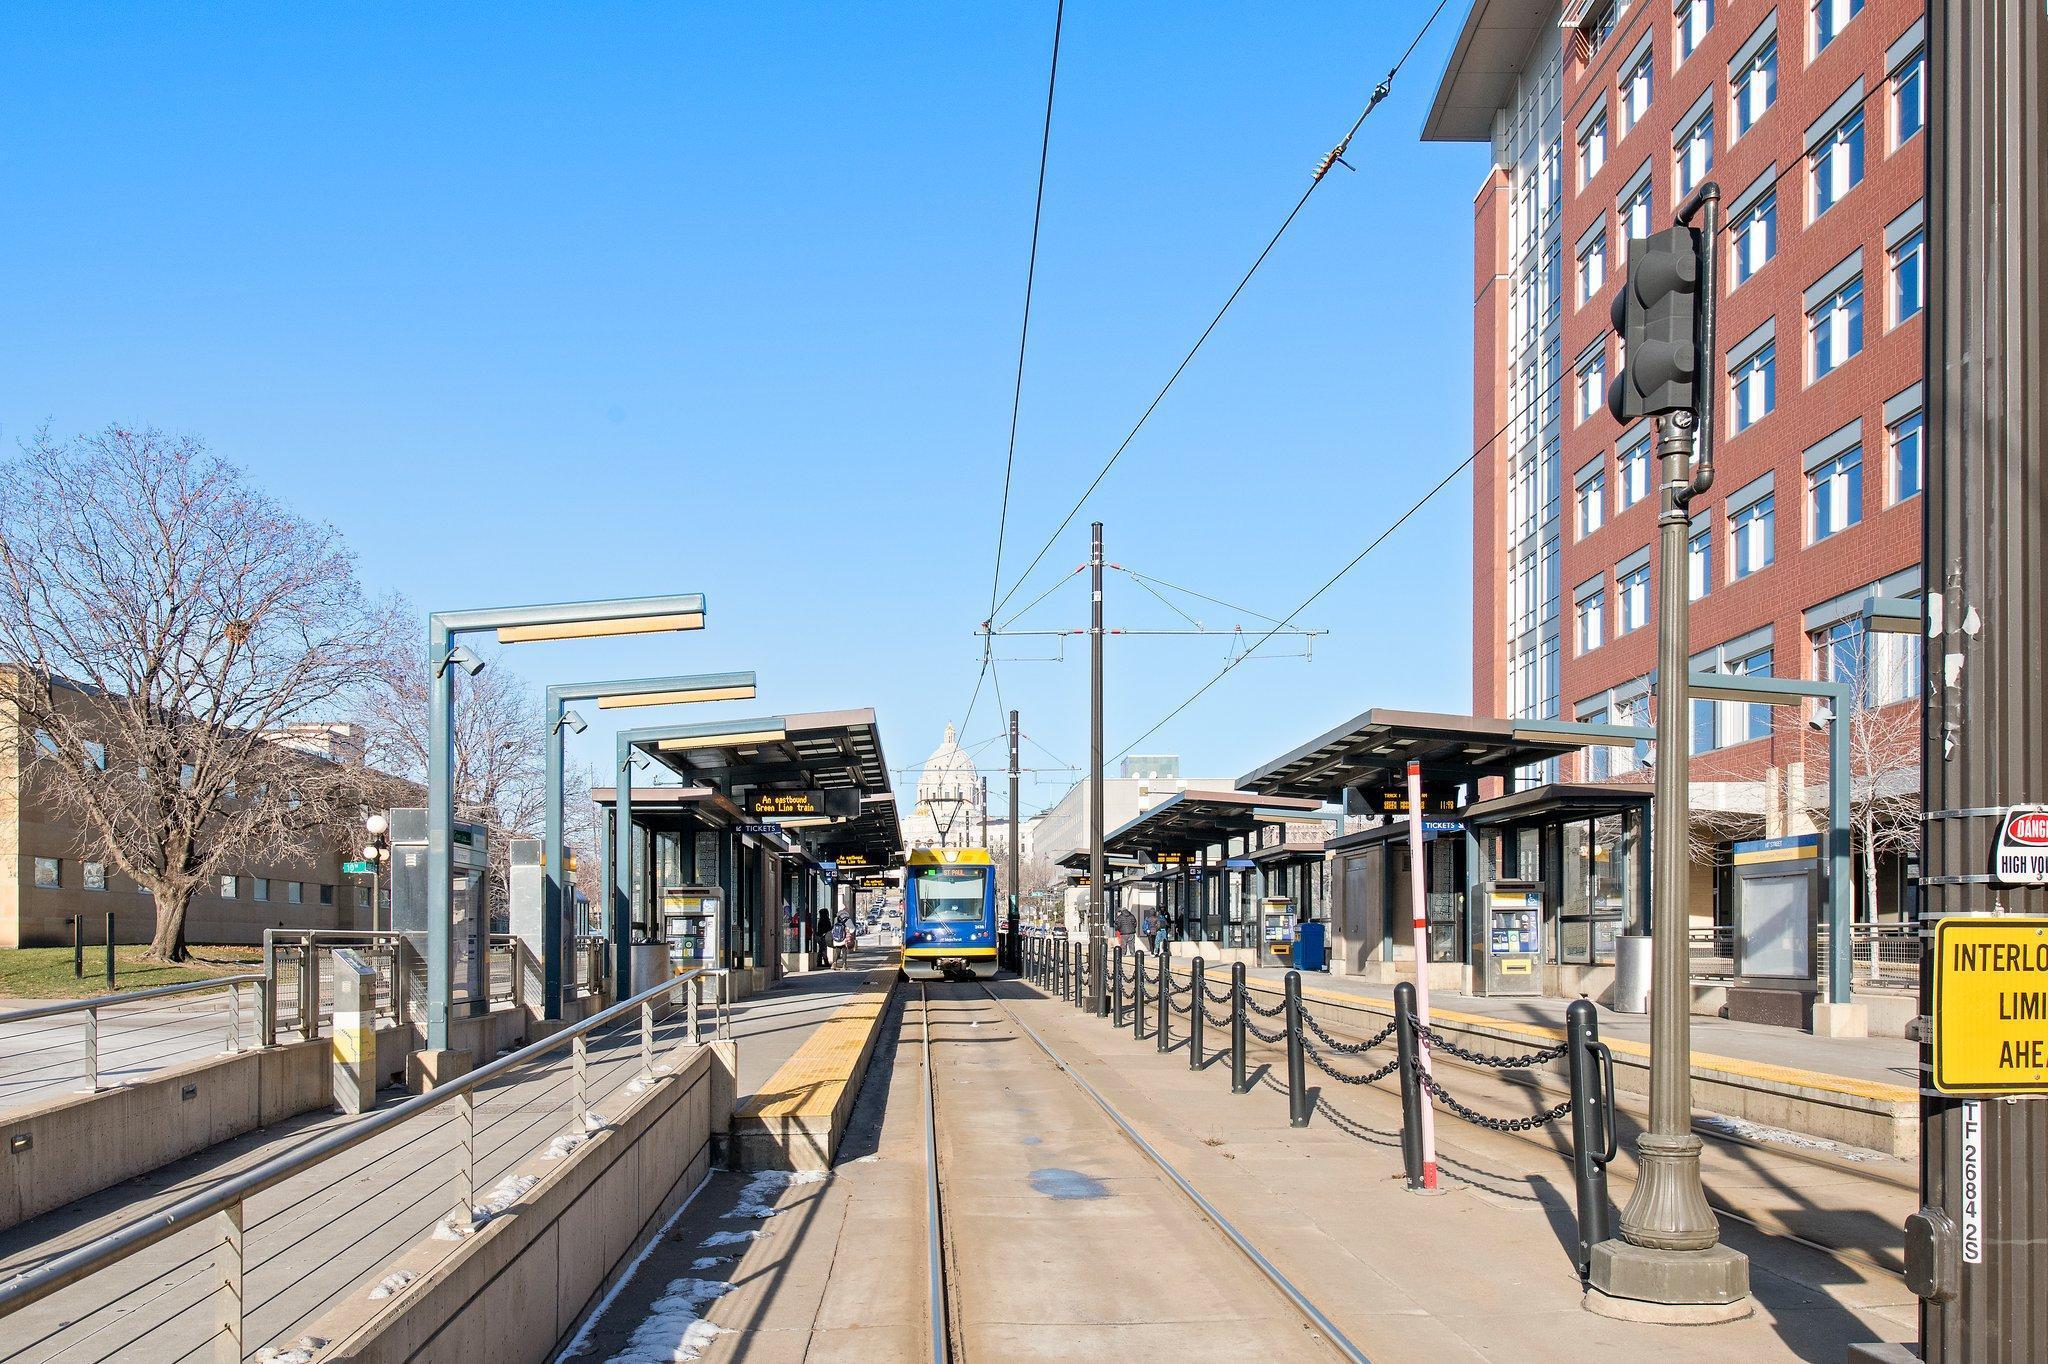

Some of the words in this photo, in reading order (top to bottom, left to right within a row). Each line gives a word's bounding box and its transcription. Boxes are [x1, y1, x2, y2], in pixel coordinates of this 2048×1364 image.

[755, 803, 775, 812] Green
[778, 803, 794, 812] Line
[796, 803, 815, 812] train
[762, 795, 772, 804] An
[774, 795, 808, 804] eastbound
[2001, 855, 2027, 874] HIGH
[1953, 943, 2048, 972] INTERLO
[1999, 1040, 2048, 1069] AHE
[1964, 1102, 1978, 1139] TF
[1965, 1144, 1977, 1218] 2684
[1965, 1223, 1979, 1260] 2S
